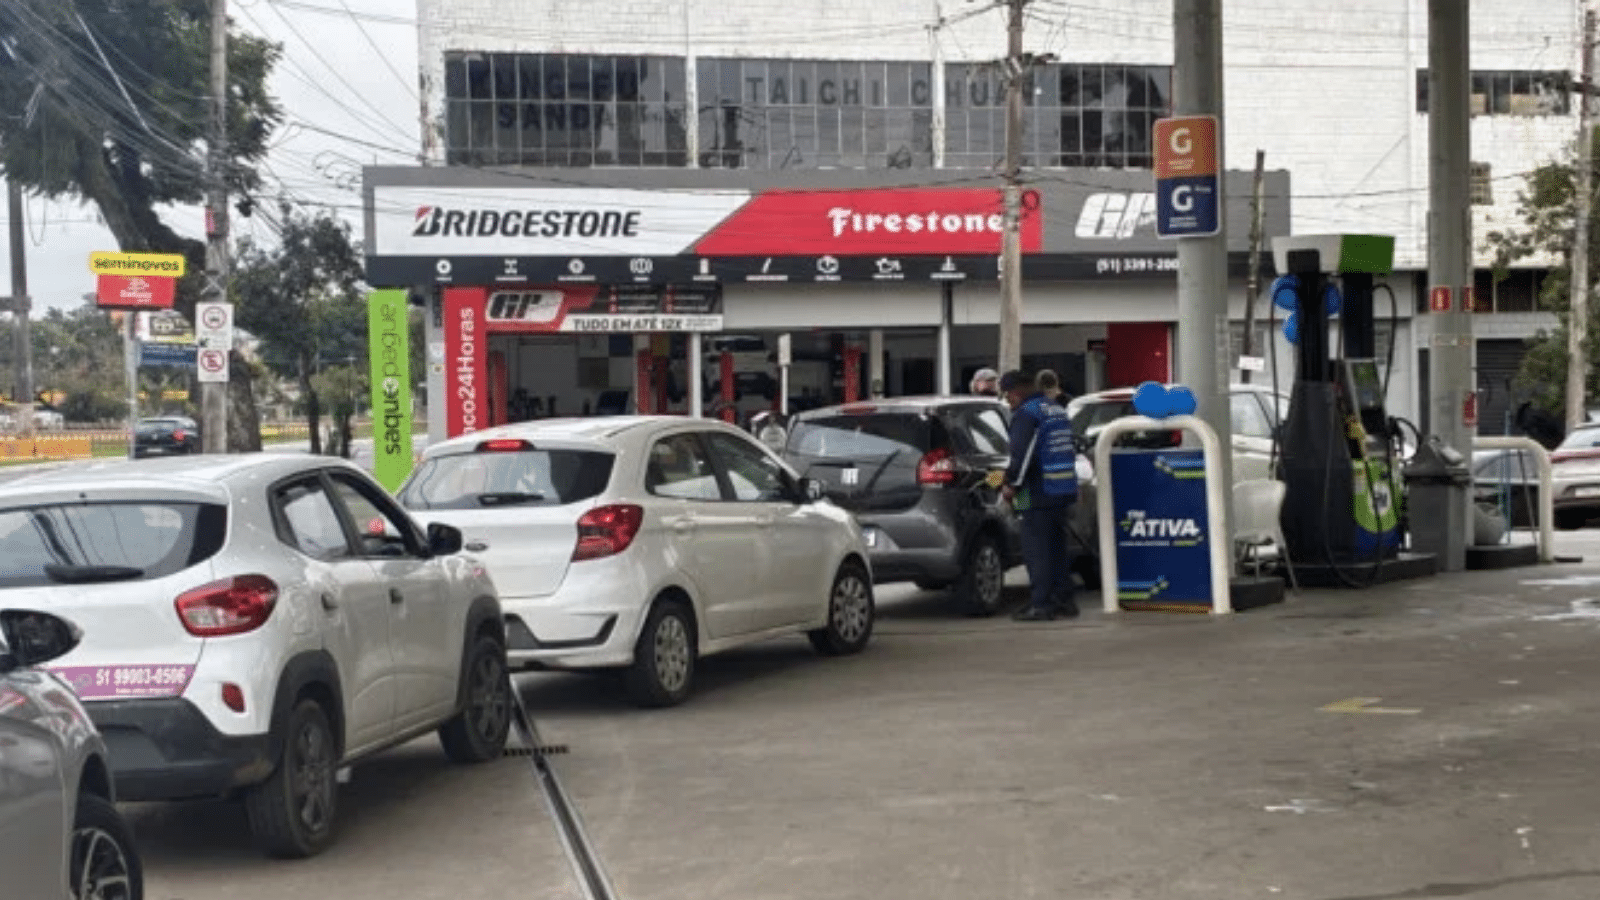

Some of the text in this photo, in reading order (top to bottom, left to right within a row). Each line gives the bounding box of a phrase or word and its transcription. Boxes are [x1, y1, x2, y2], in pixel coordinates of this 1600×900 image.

[745, 77, 880, 104] TAICHI
[1169, 127, 1193, 156] G
[1171, 185, 1195, 212] G
[412, 205, 642, 237] BRIDGESTONE
[827, 207, 1004, 236] Firestone
[94, 256, 180, 271] seminovos
[1096, 258, 1179, 274] (51) 3391-200
[573, 319, 610, 330] TUDO
[612, 319, 631, 330] EM
[633, 317, 658, 330] ATÉ
[660, 319, 683, 330] 12X
[380, 303, 402, 378] pague
[457, 307, 476, 435] nco24Horas
[1130, 518, 1199, 537] ATIVA
[95, 668, 110, 686] 51
